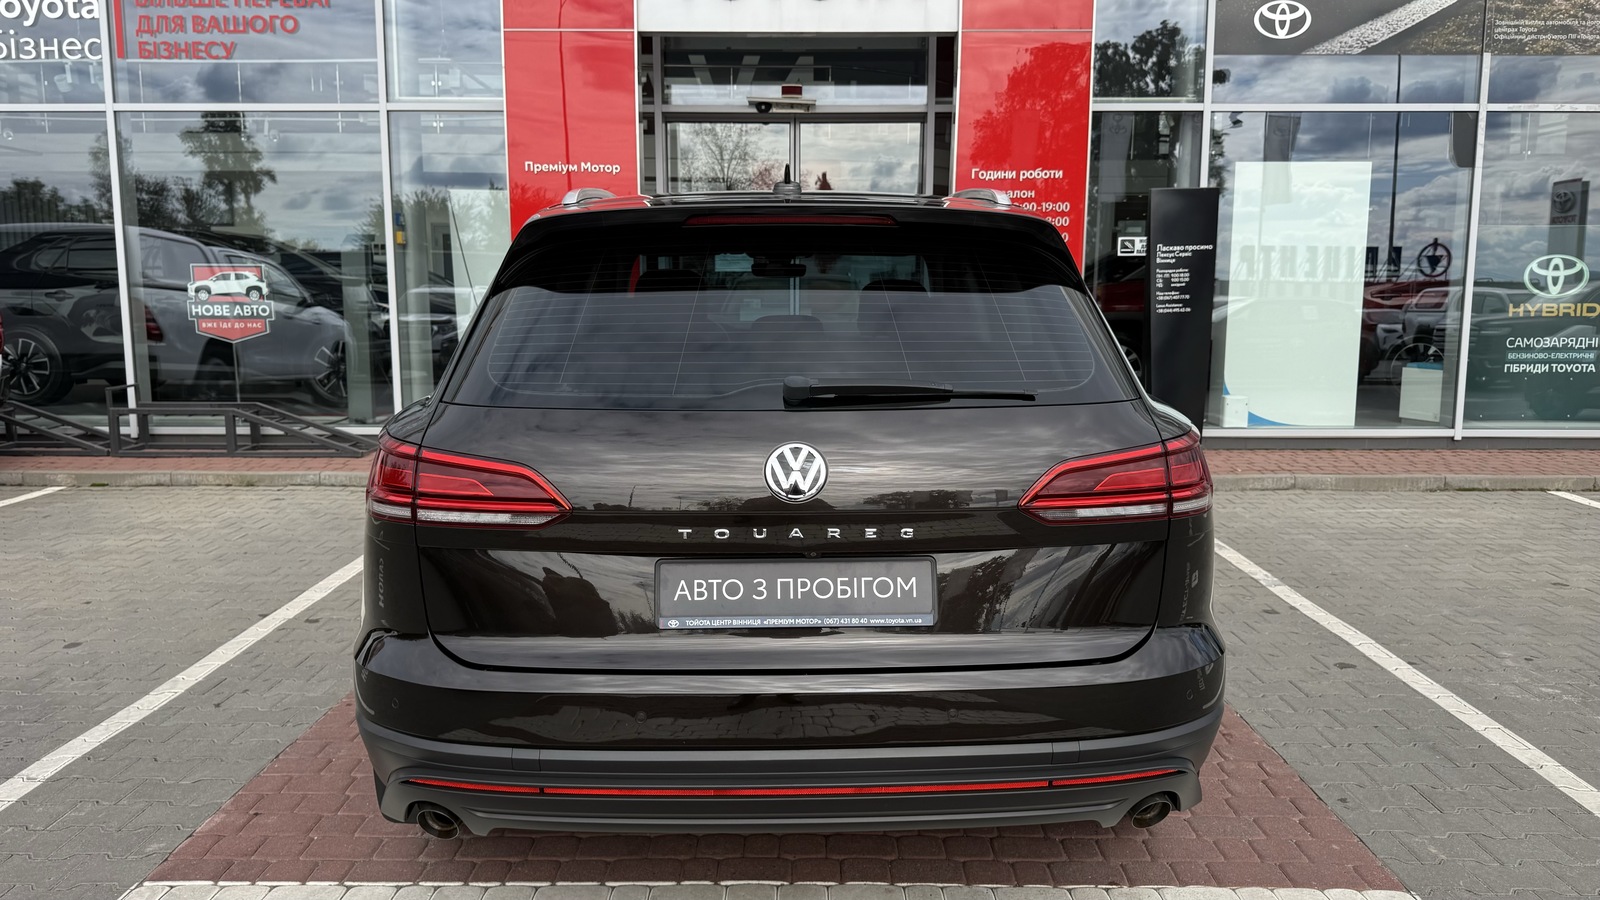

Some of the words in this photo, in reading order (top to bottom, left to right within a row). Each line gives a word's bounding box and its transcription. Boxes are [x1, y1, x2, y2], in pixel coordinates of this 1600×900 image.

[136, 15, 184, 37] ДЛЯ
[191, 15, 299, 34] ВАШОГО
[138, 41, 235, 59] БІЗНЕСУ
[524, 161, 578, 174] Преміум
[581, 162, 620, 175] Мотор
[971, 168, 1016, 181] Години
[1019, 168, 1063, 181] роботи
[1005, 190, 1035, 198] алон
[191, 305, 231, 316] НОВЕ
[233, 305, 270, 316] АВТО
[1508, 303, 1600, 317] HYBRID
[1506, 337, 1599, 349] САМОЗАРЯДНІ
[1507, 352, 1595, 360] БЕНЗИНОВО-ЕЛЕКТРИЧНІ
[1504, 364, 1549, 374] ГІБРИДИ
[1550, 363, 1596, 373] TOYOTA
[766, 443, 826, 499] VW
[678, 528, 915, 540] TOUAREG
[673, 579, 744, 601] АВТО
[752, 578, 767, 600] З
[777, 576, 917, 600] ПРОБІГОМ
[711, 619, 731, 627] ЦЕНТР
